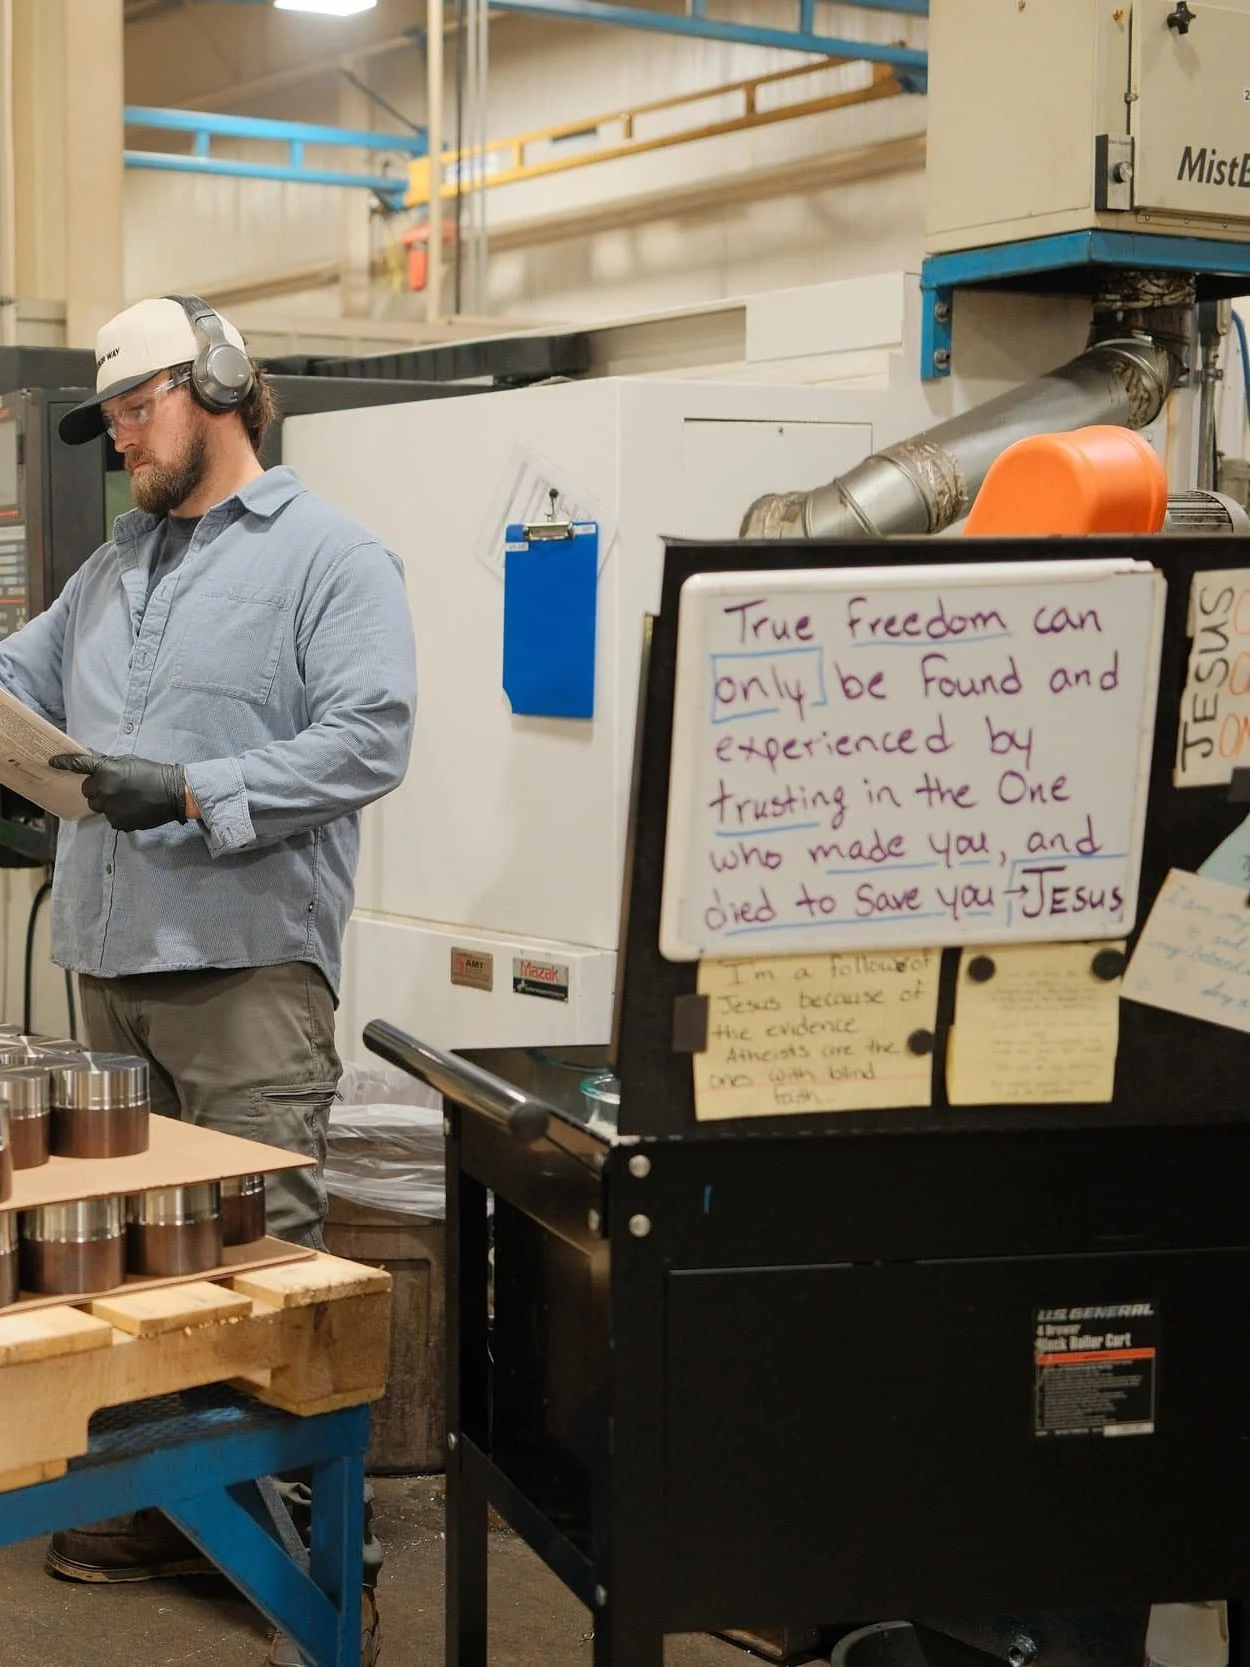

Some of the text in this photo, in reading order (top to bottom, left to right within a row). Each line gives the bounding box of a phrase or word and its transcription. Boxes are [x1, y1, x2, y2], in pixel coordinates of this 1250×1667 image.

[724, 599, 815, 642] True
[1034, 605, 1103, 635] can
[716, 669, 805, 721] only
[838, 660, 886, 700] be
[1049, 650, 1119, 693] and
[1181, 585, 1235, 773] JESUS
[715, 714, 1033, 776] experienced by
[710, 769, 1070, 830] trusting in the One
[710, 814, 1103, 872] who made you, and
[705, 888, 776, 930] died
[796, 884, 836, 916] to
[937, 884, 995, 921] you
[519, 960, 559, 982] Mazak
[793, 966, 814, 981] a
[715, 979, 926, 1016] Jesus because of
[711, 1016, 857, 1040] the evidence
[726, 1039, 901, 1064] Atheists are the
[768, 1066, 817, 1083] with
[829, 1061, 876, 1081] blind
[1069, 1303, 1154, 1320] GENERAL
